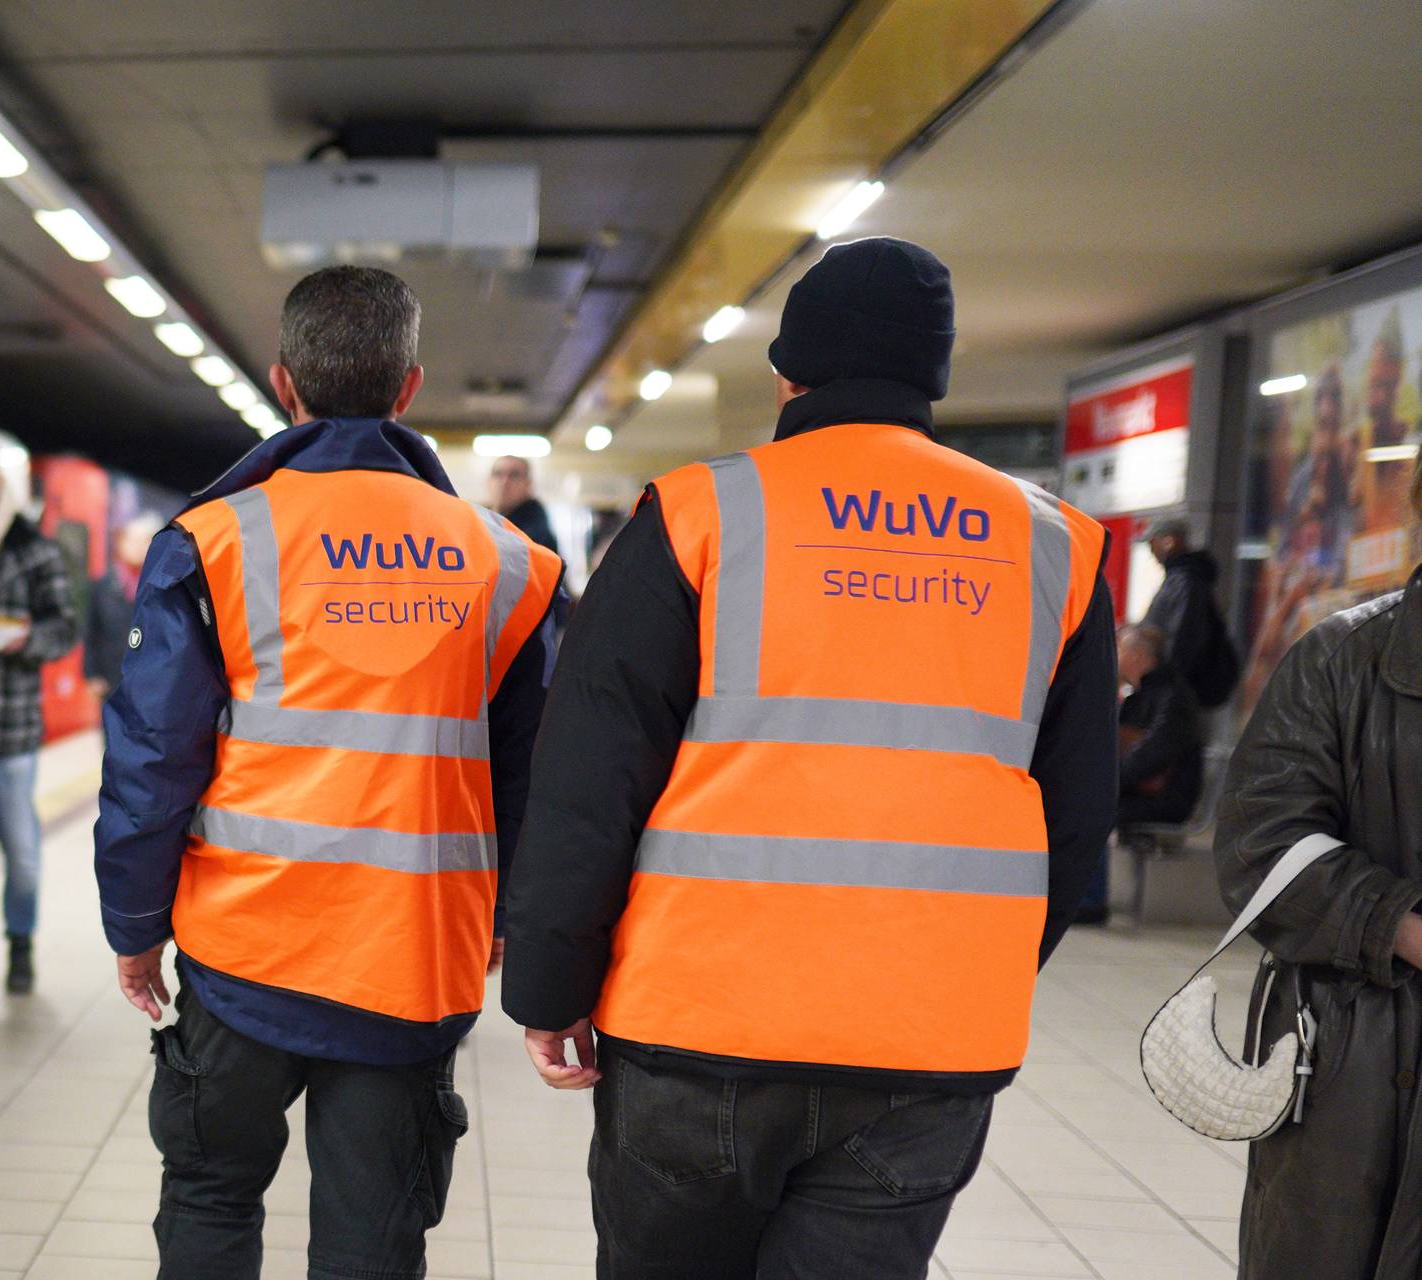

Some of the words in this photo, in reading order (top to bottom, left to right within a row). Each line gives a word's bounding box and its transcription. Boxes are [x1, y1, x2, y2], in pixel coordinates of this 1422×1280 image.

[821, 487, 990, 542] WuVo
[321, 533, 465, 571] WuVo
[324, 593, 470, 630] security
[823, 568, 991, 616] security
